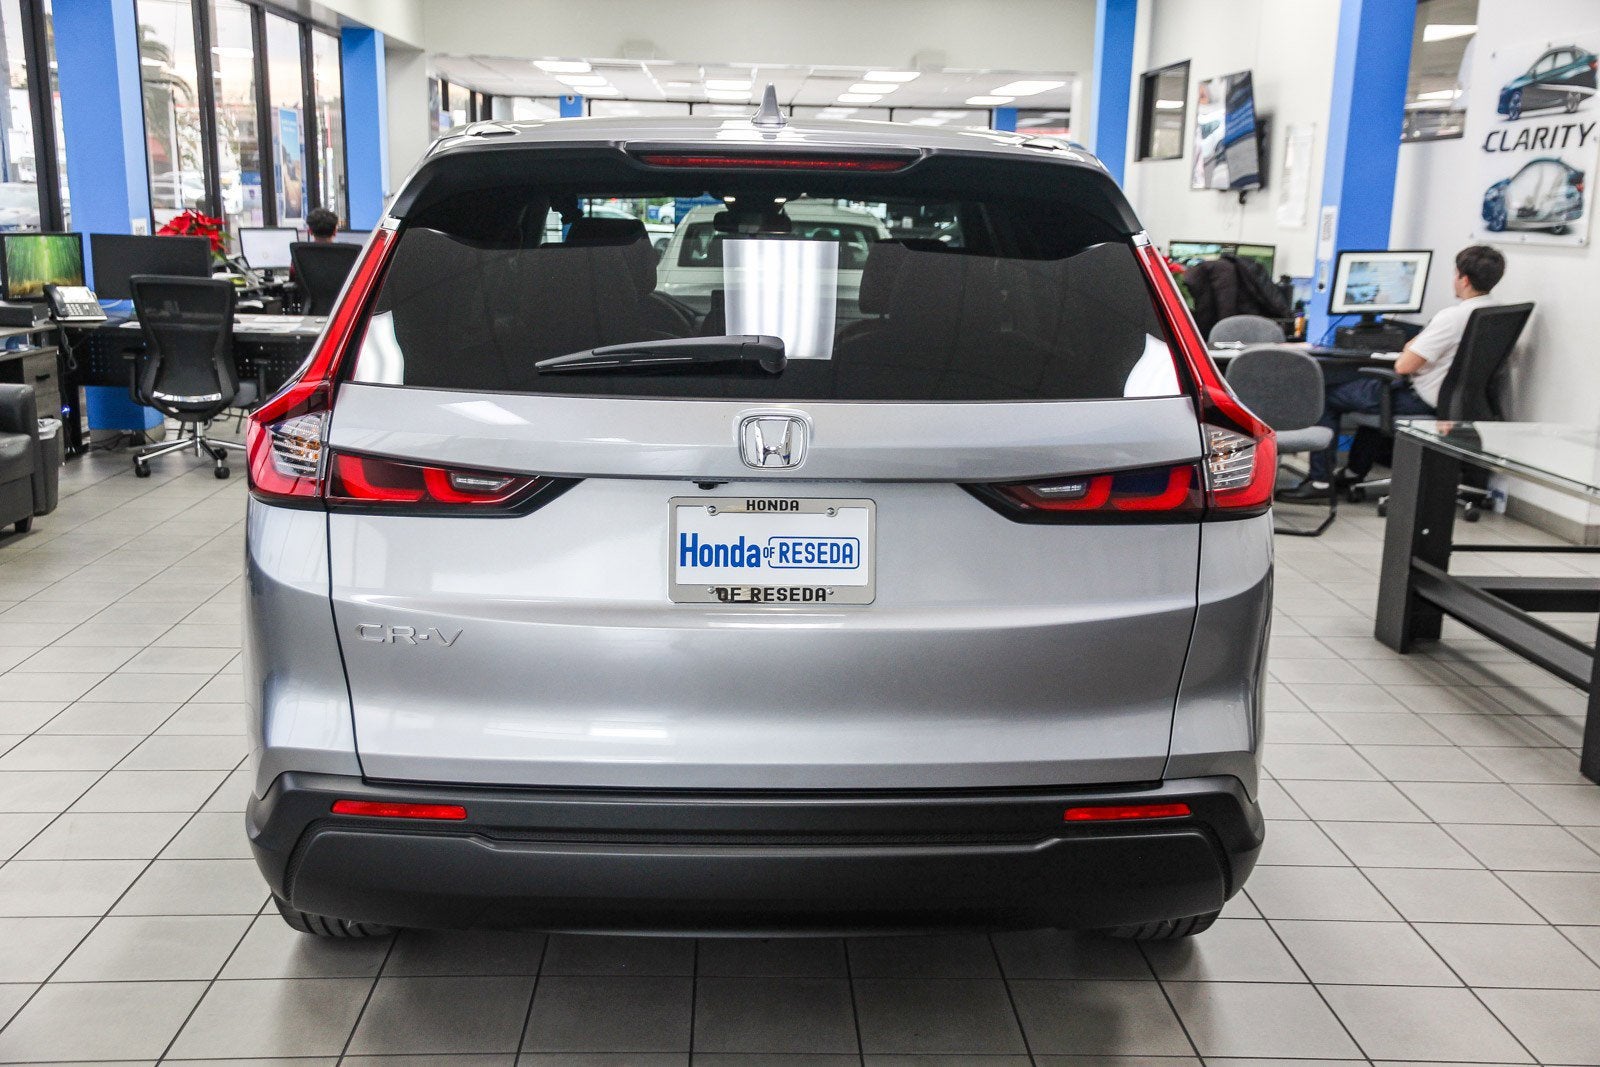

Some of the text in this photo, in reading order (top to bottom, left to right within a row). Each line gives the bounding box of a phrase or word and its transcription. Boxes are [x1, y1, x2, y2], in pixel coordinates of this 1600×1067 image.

[1483, 121, 1597, 153] CLARITY
[746, 499, 800, 512] HONDA
[679, 532, 853, 568] Honda OF RESEDA
[750, 587, 827, 602] RESEDA
[354, 623, 464, 648] CR-V
